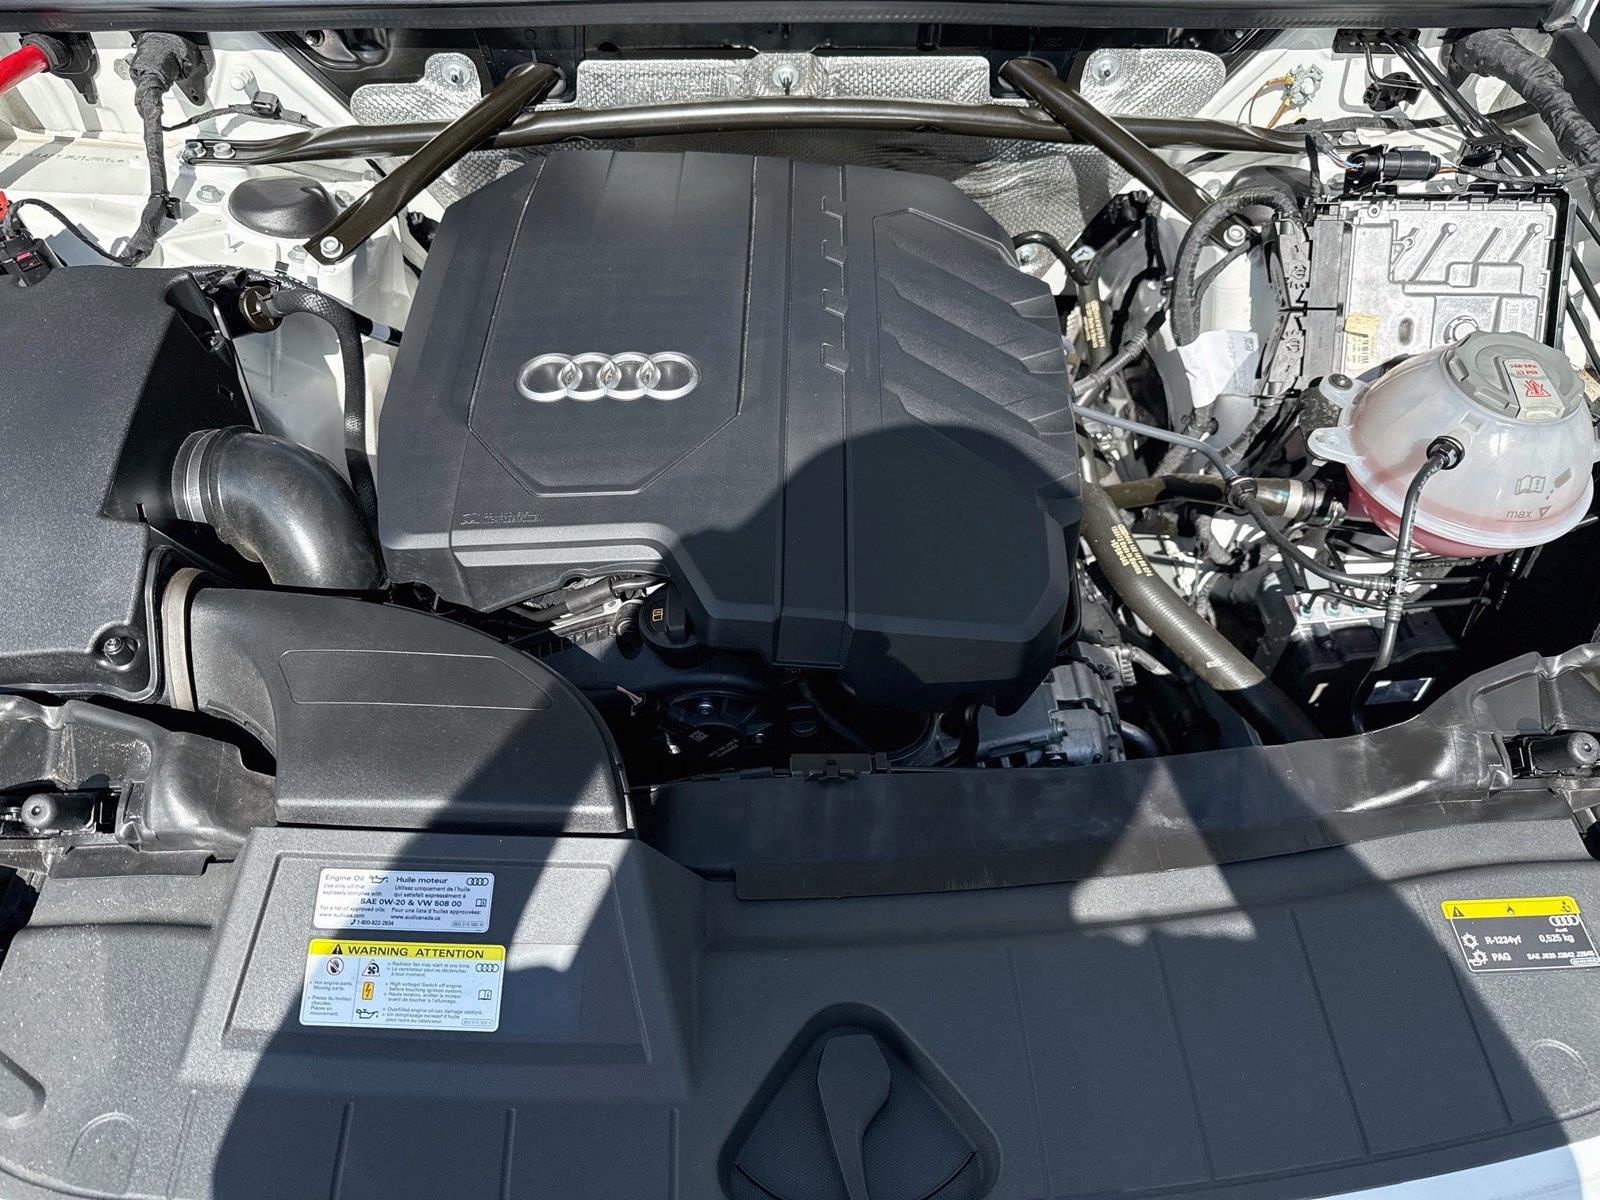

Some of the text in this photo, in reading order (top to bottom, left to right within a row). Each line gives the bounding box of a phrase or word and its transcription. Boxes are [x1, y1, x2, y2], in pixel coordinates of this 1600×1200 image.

[1485, 933, 1575, 945] R-1234yf 0,525 kg
[348, 946, 484, 958] WARNING ATTENTION
[1491, 952, 1512, 961] PAG
